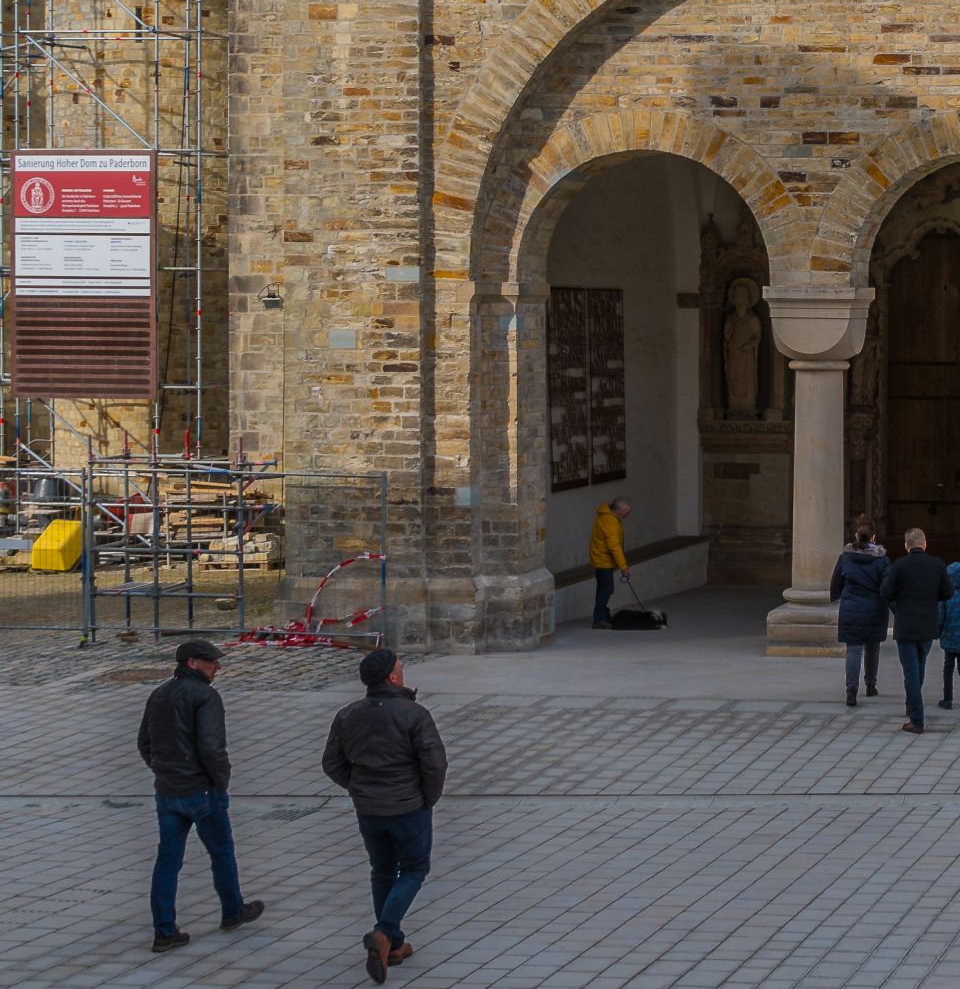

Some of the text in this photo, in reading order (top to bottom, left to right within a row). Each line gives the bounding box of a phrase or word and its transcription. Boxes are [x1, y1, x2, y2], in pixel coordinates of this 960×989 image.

[17, 158, 148, 170] Sanierung Hoher Dom zu Paderborn
